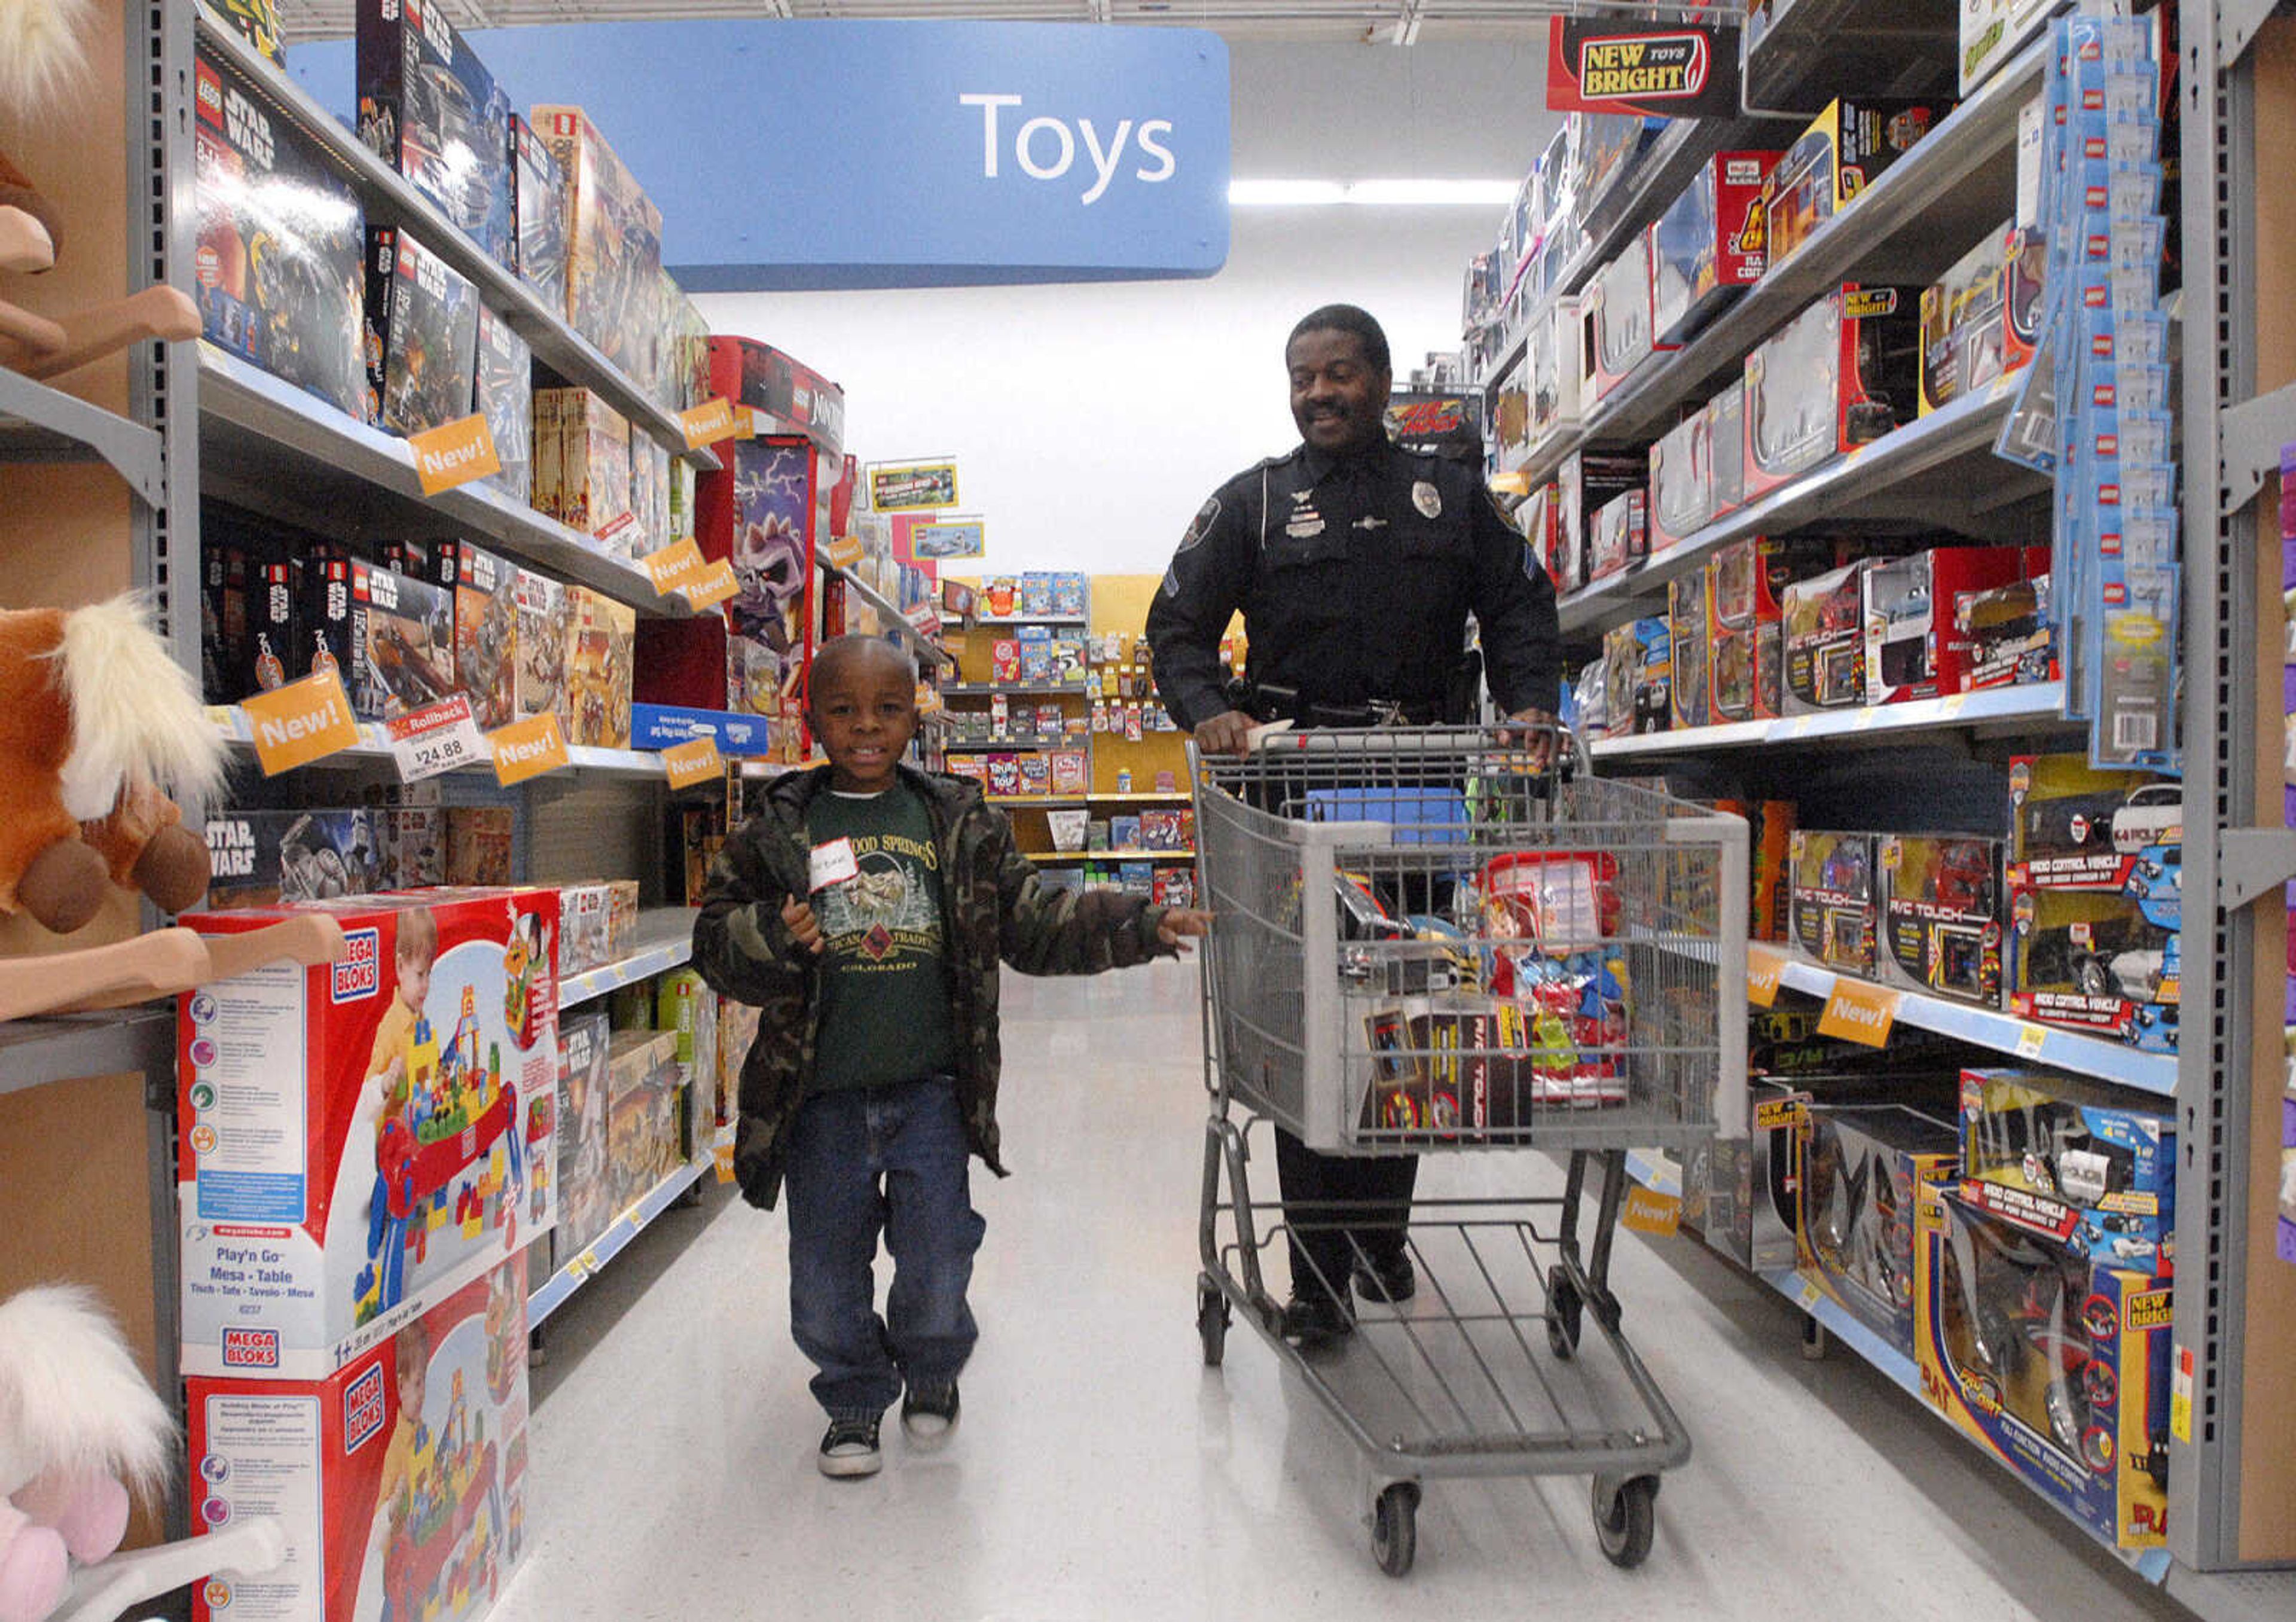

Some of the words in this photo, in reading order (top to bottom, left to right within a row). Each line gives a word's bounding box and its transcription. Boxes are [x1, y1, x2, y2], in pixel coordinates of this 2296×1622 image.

[1587, 44, 1646, 69] NEW
[1650, 47, 1686, 60] TOYS
[1585, 65, 1684, 94] BRIGHT
[960, 94, 1176, 205] Toys
[422, 437, 486, 475] New!
[654, 551, 698, 581] New!
[370, 570, 397, 594] STAR
[371, 588, 399, 610] WARS
[260, 699, 341, 748] New!
[410, 704, 464, 731] Rollback
[414, 740, 463, 764] $24.88
[499, 730, 556, 766] New!
[671, 751, 714, 775] New!
[206, 819, 255, 847] STAR
[849, 836, 878, 856] OOD
[882, 834, 938, 871] SPRINGS
[1815, 891, 1849, 906] TOUCH
[1889, 900, 1913, 915] R/C
[1916, 904, 1964, 922] TOUCH
[337, 963, 374, 992] BLOKS
[841, 961, 918, 973] COLORADO
[1831, 996, 1887, 1028] New!
[1630, 1200, 1674, 1224] New!
[216, 1246, 258, 1264] Play'n
[209, 1266, 245, 1282] Mesa
[256, 1269, 294, 1283] Table
[2131, 1297, 2166, 1312] NEW
[227, 1332, 276, 1347] MEGA
[227, 1349, 276, 1365] BLOKS
[349, 1376, 380, 1412] MEGA
[349, 1398, 381, 1443] BLOKS
